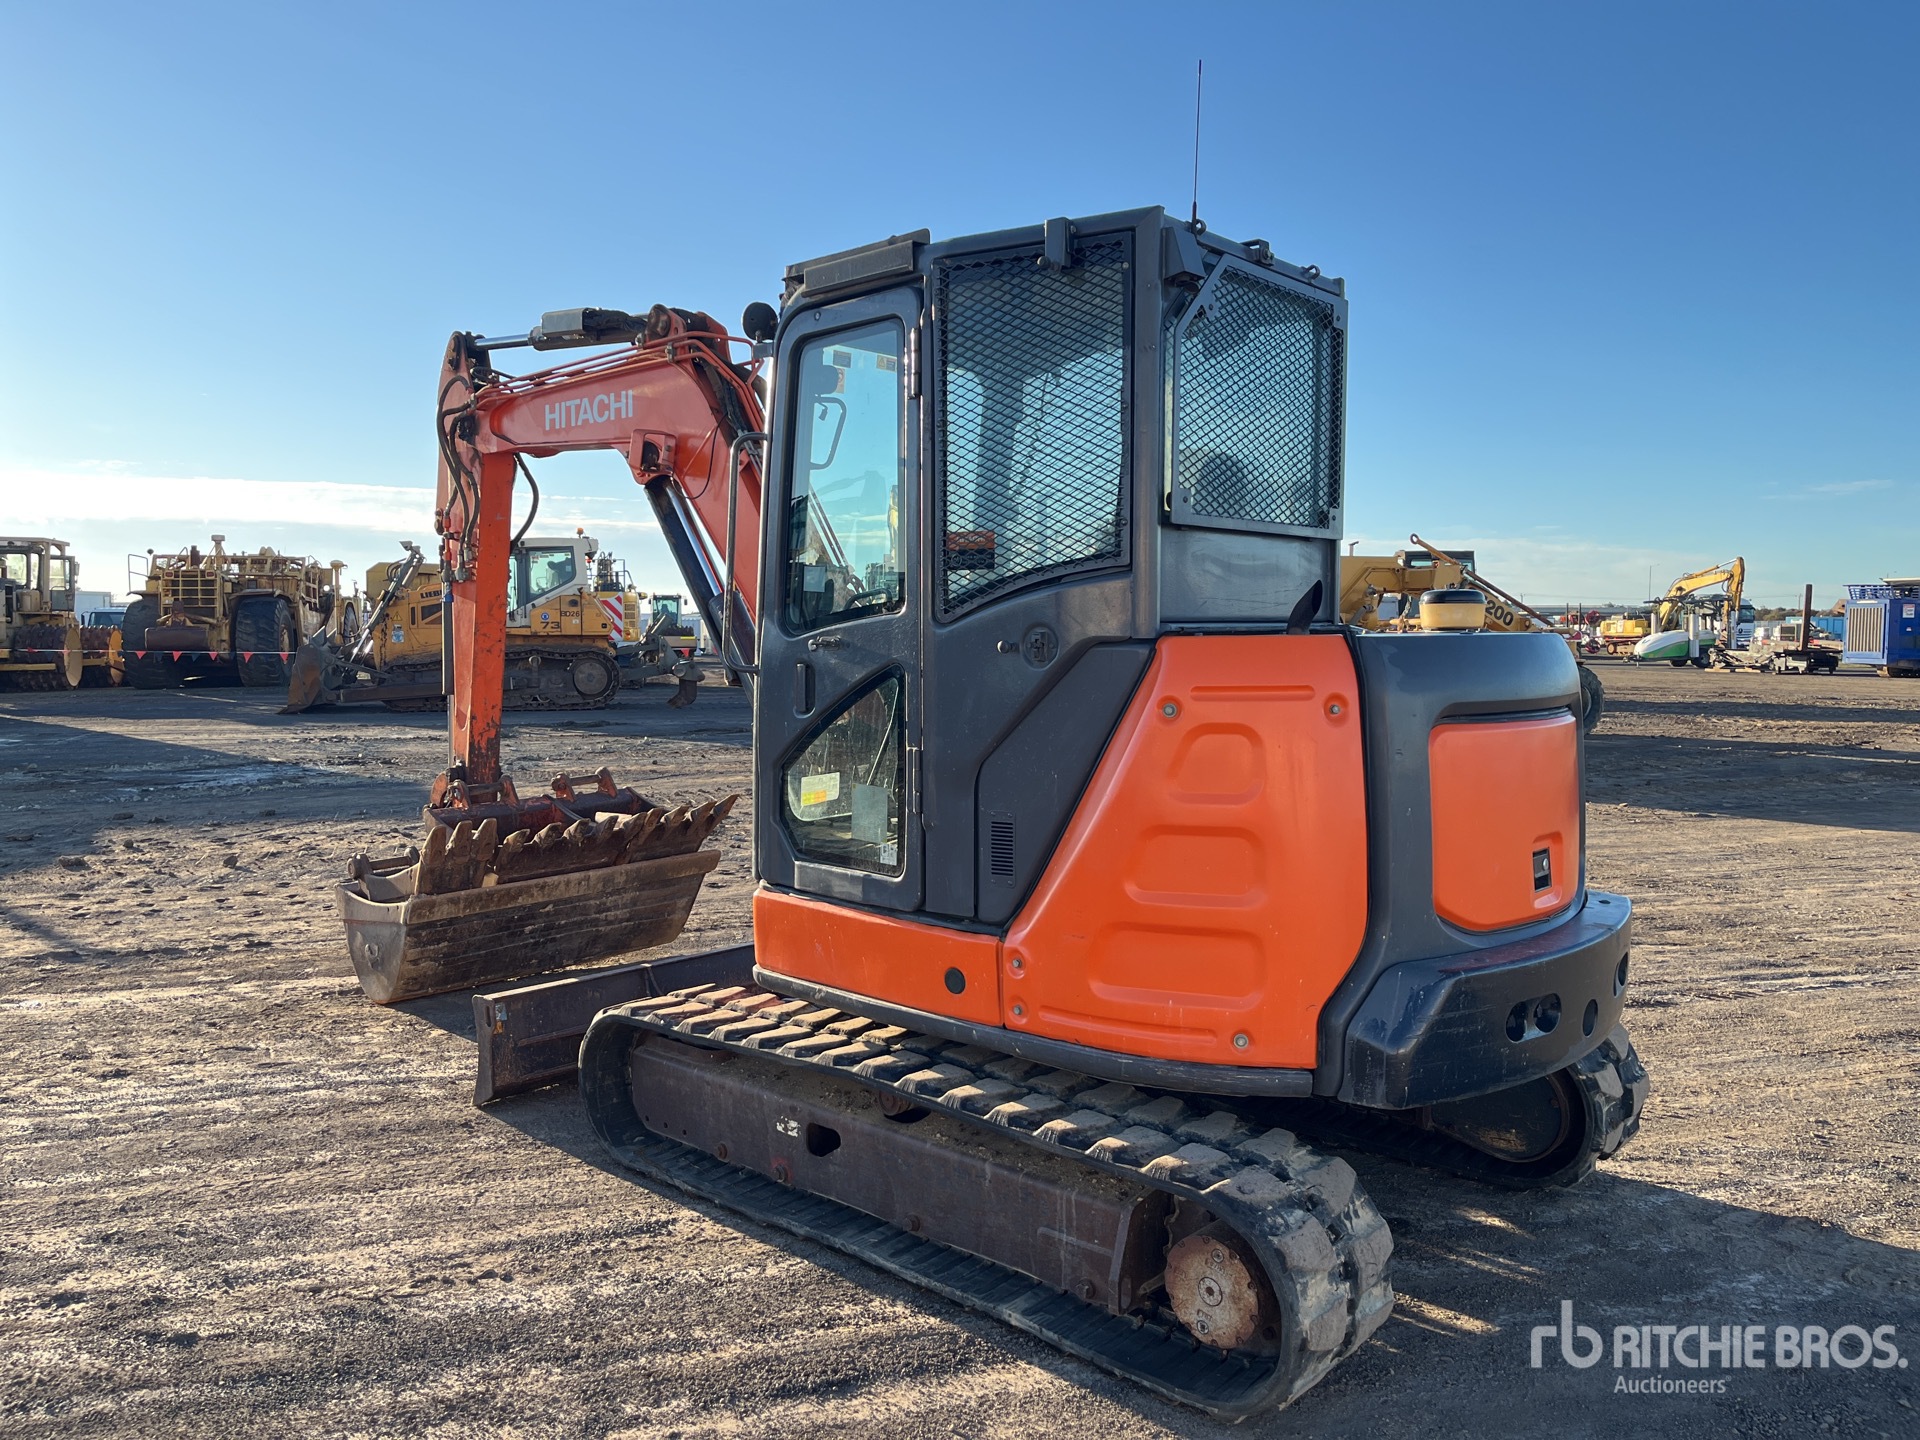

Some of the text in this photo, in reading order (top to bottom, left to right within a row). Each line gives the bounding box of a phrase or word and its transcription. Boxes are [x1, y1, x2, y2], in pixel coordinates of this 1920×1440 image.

[544, 389, 634, 431] HITACHI
[540, 621, 560, 630] 73
[1485, 594, 1514, 626] 200
